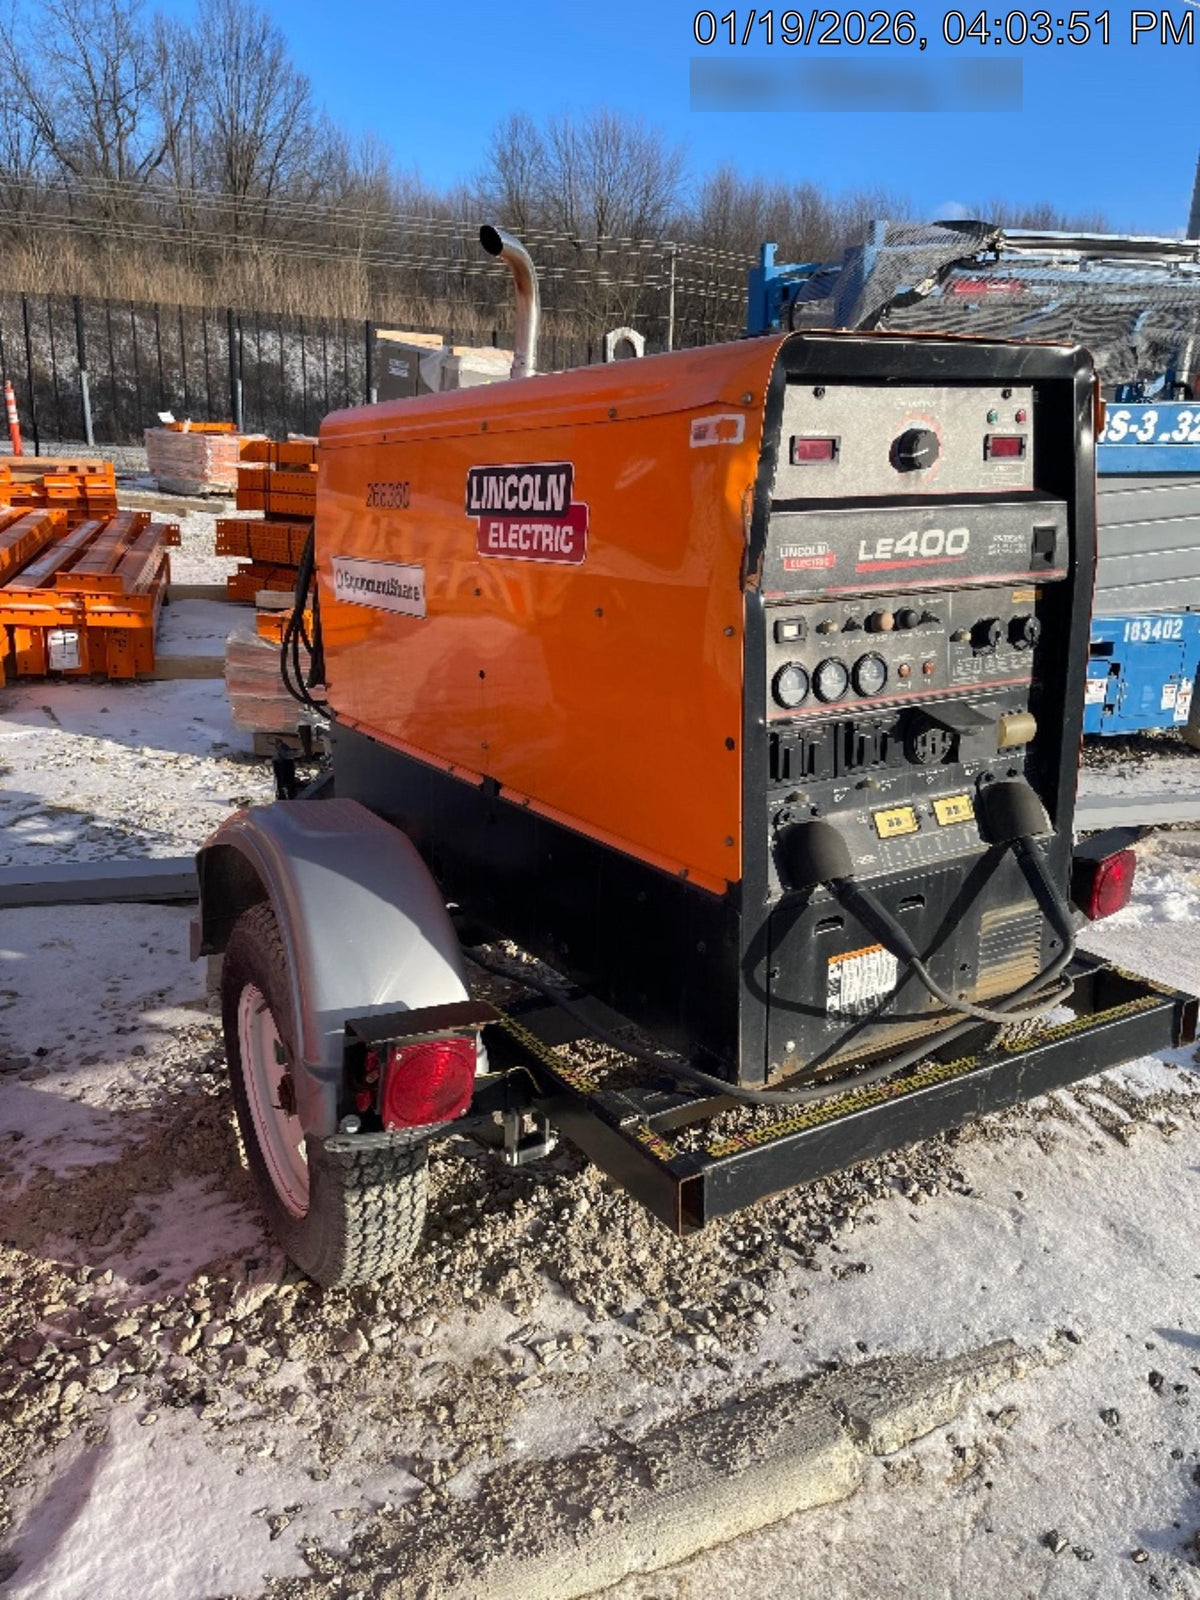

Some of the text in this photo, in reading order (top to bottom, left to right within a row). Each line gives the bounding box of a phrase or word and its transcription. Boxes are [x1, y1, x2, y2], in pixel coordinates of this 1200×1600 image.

[469, 473, 567, 511] LINCOLN
[488, 522, 574, 553] ELECTRIC
[780, 545, 826, 559] LINCOLN
[857, 527, 971, 561] LE400
[1123, 618, 1184, 643] 183402
